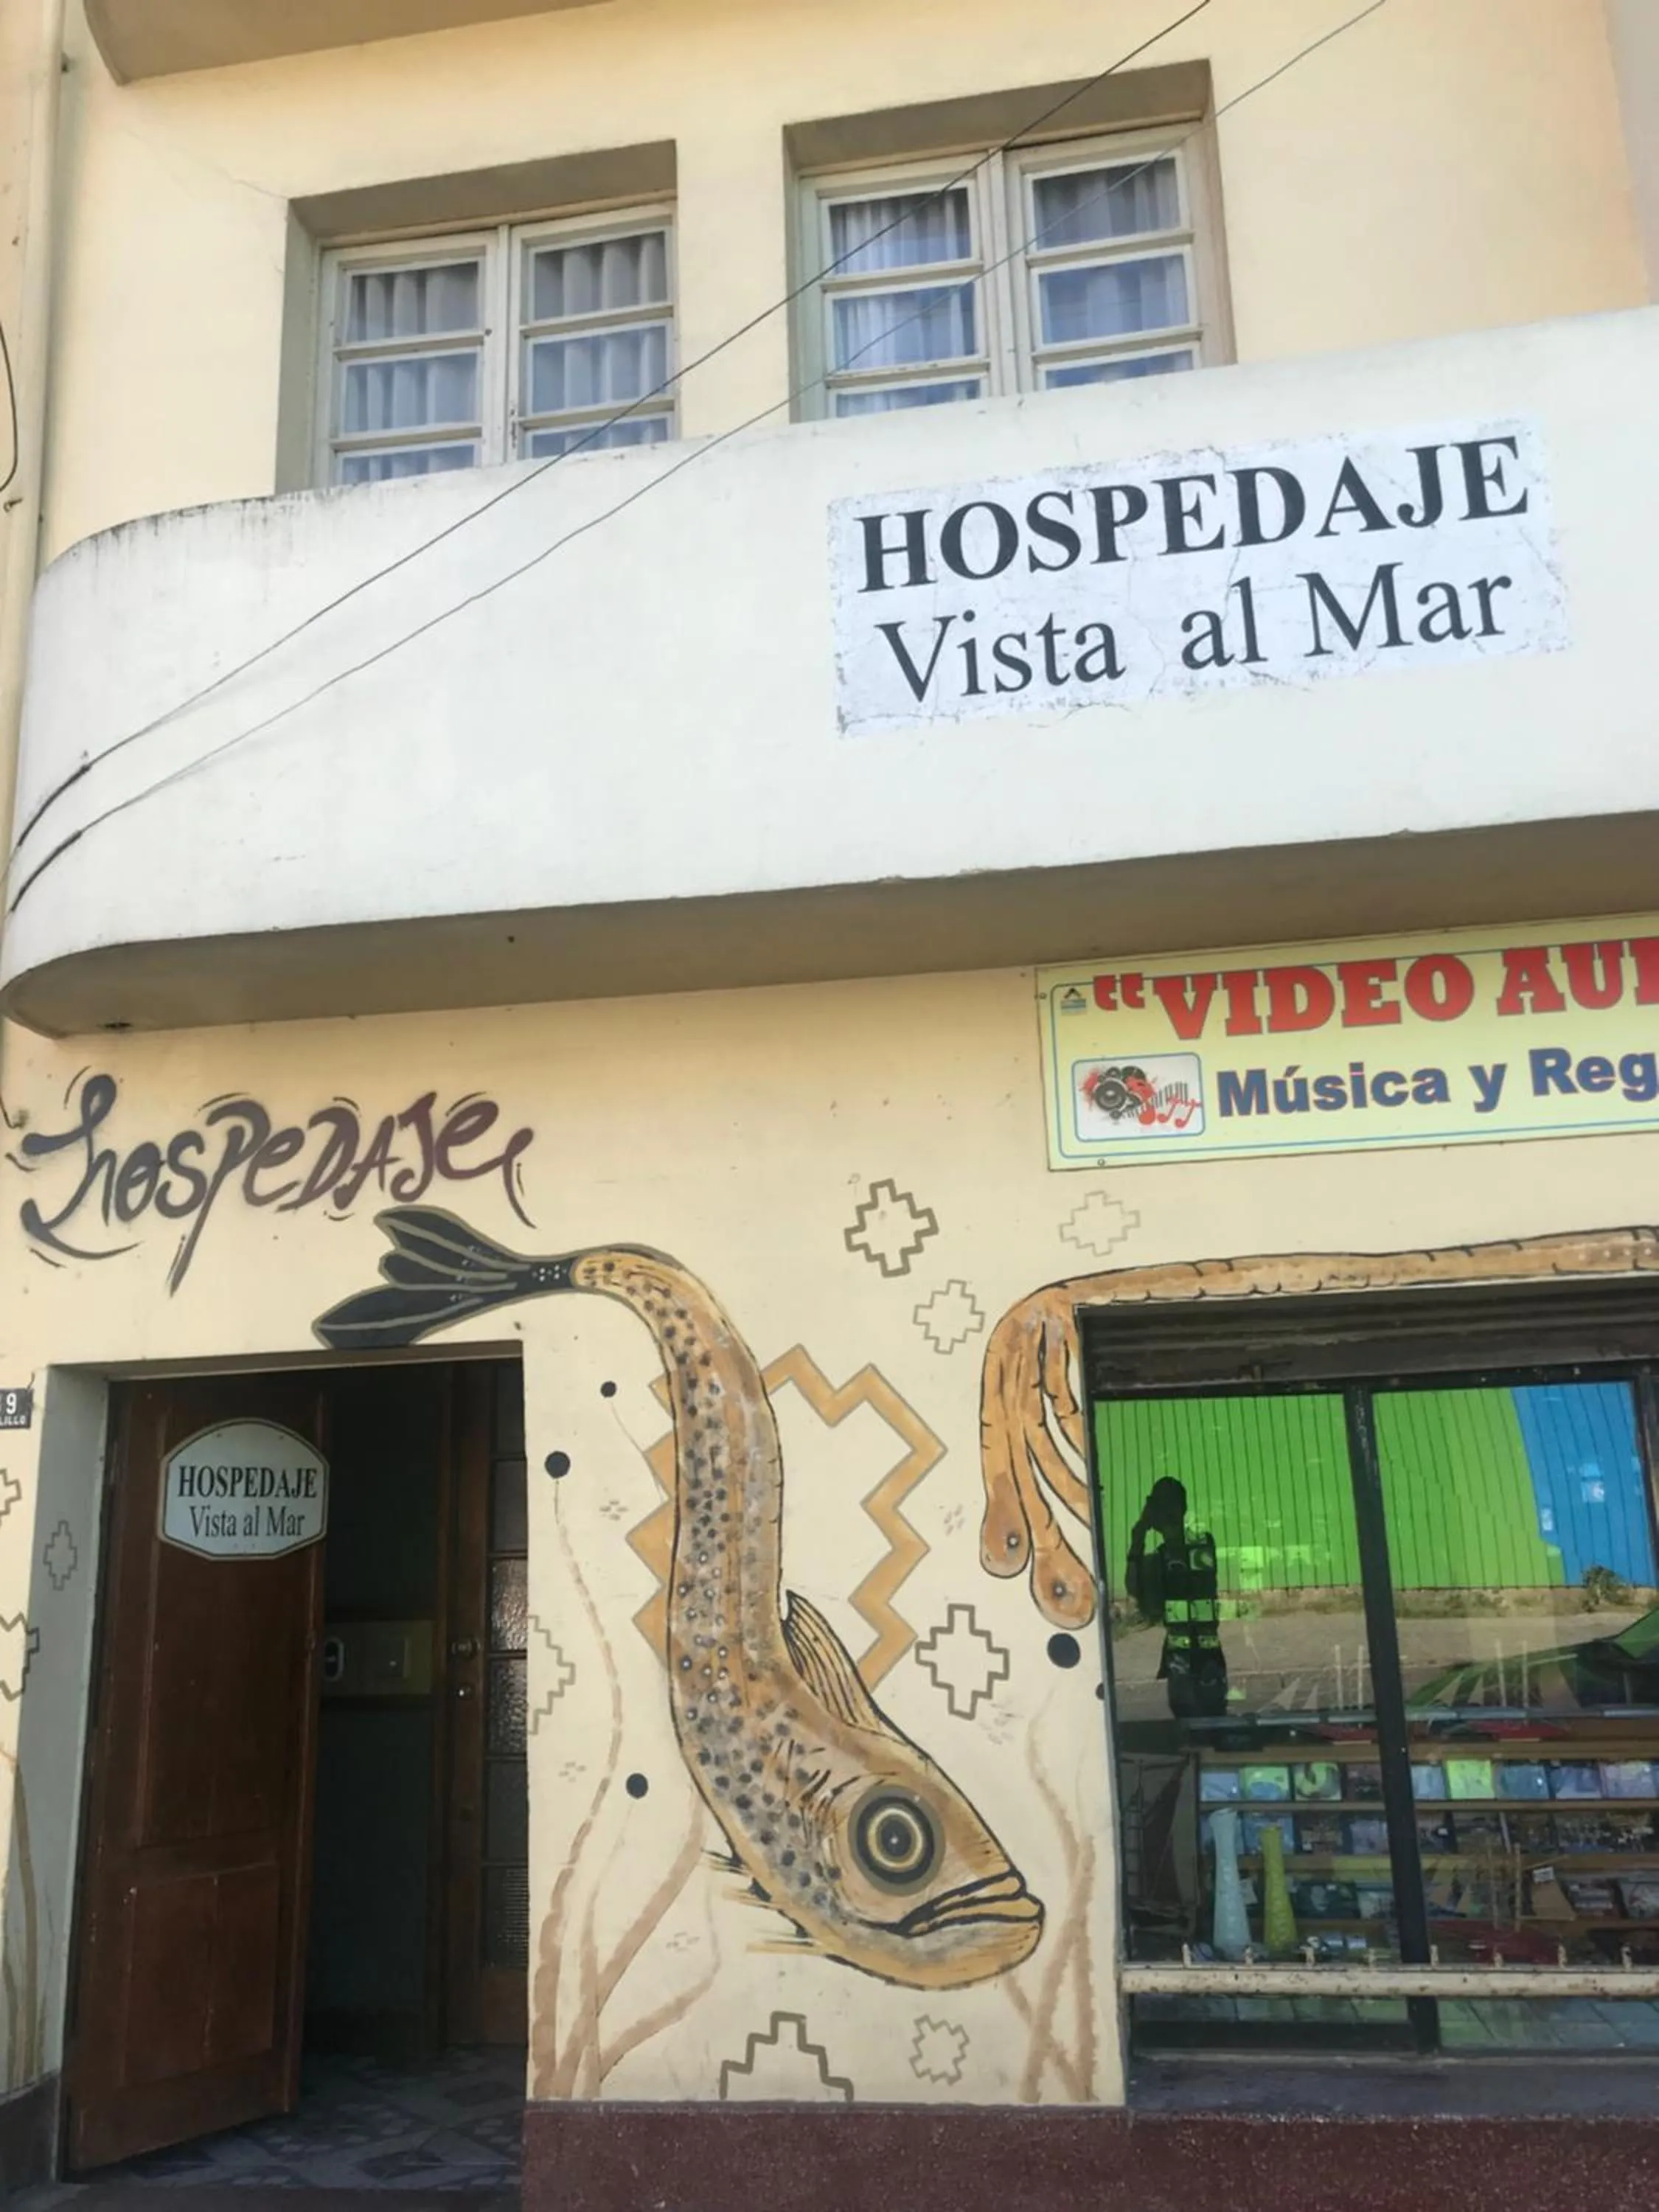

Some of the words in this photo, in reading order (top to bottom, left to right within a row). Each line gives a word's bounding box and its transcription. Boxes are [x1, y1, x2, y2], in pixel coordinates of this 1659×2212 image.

[856, 436, 1528, 593] HOSPEDAJE
[874, 610, 1127, 703] Vista
[1180, 577, 1268, 671] al
[1295, 562, 1513, 658] Mar
[1217, 1062, 1450, 1118] Música
[1470, 1063, 1507, 1113] y
[178, 1464, 318, 1499] HOSPEDAJE
[189, 1504, 237, 1537] Vista
[243, 1505, 260, 1537] al
[266, 1506, 305, 1537] Mar
